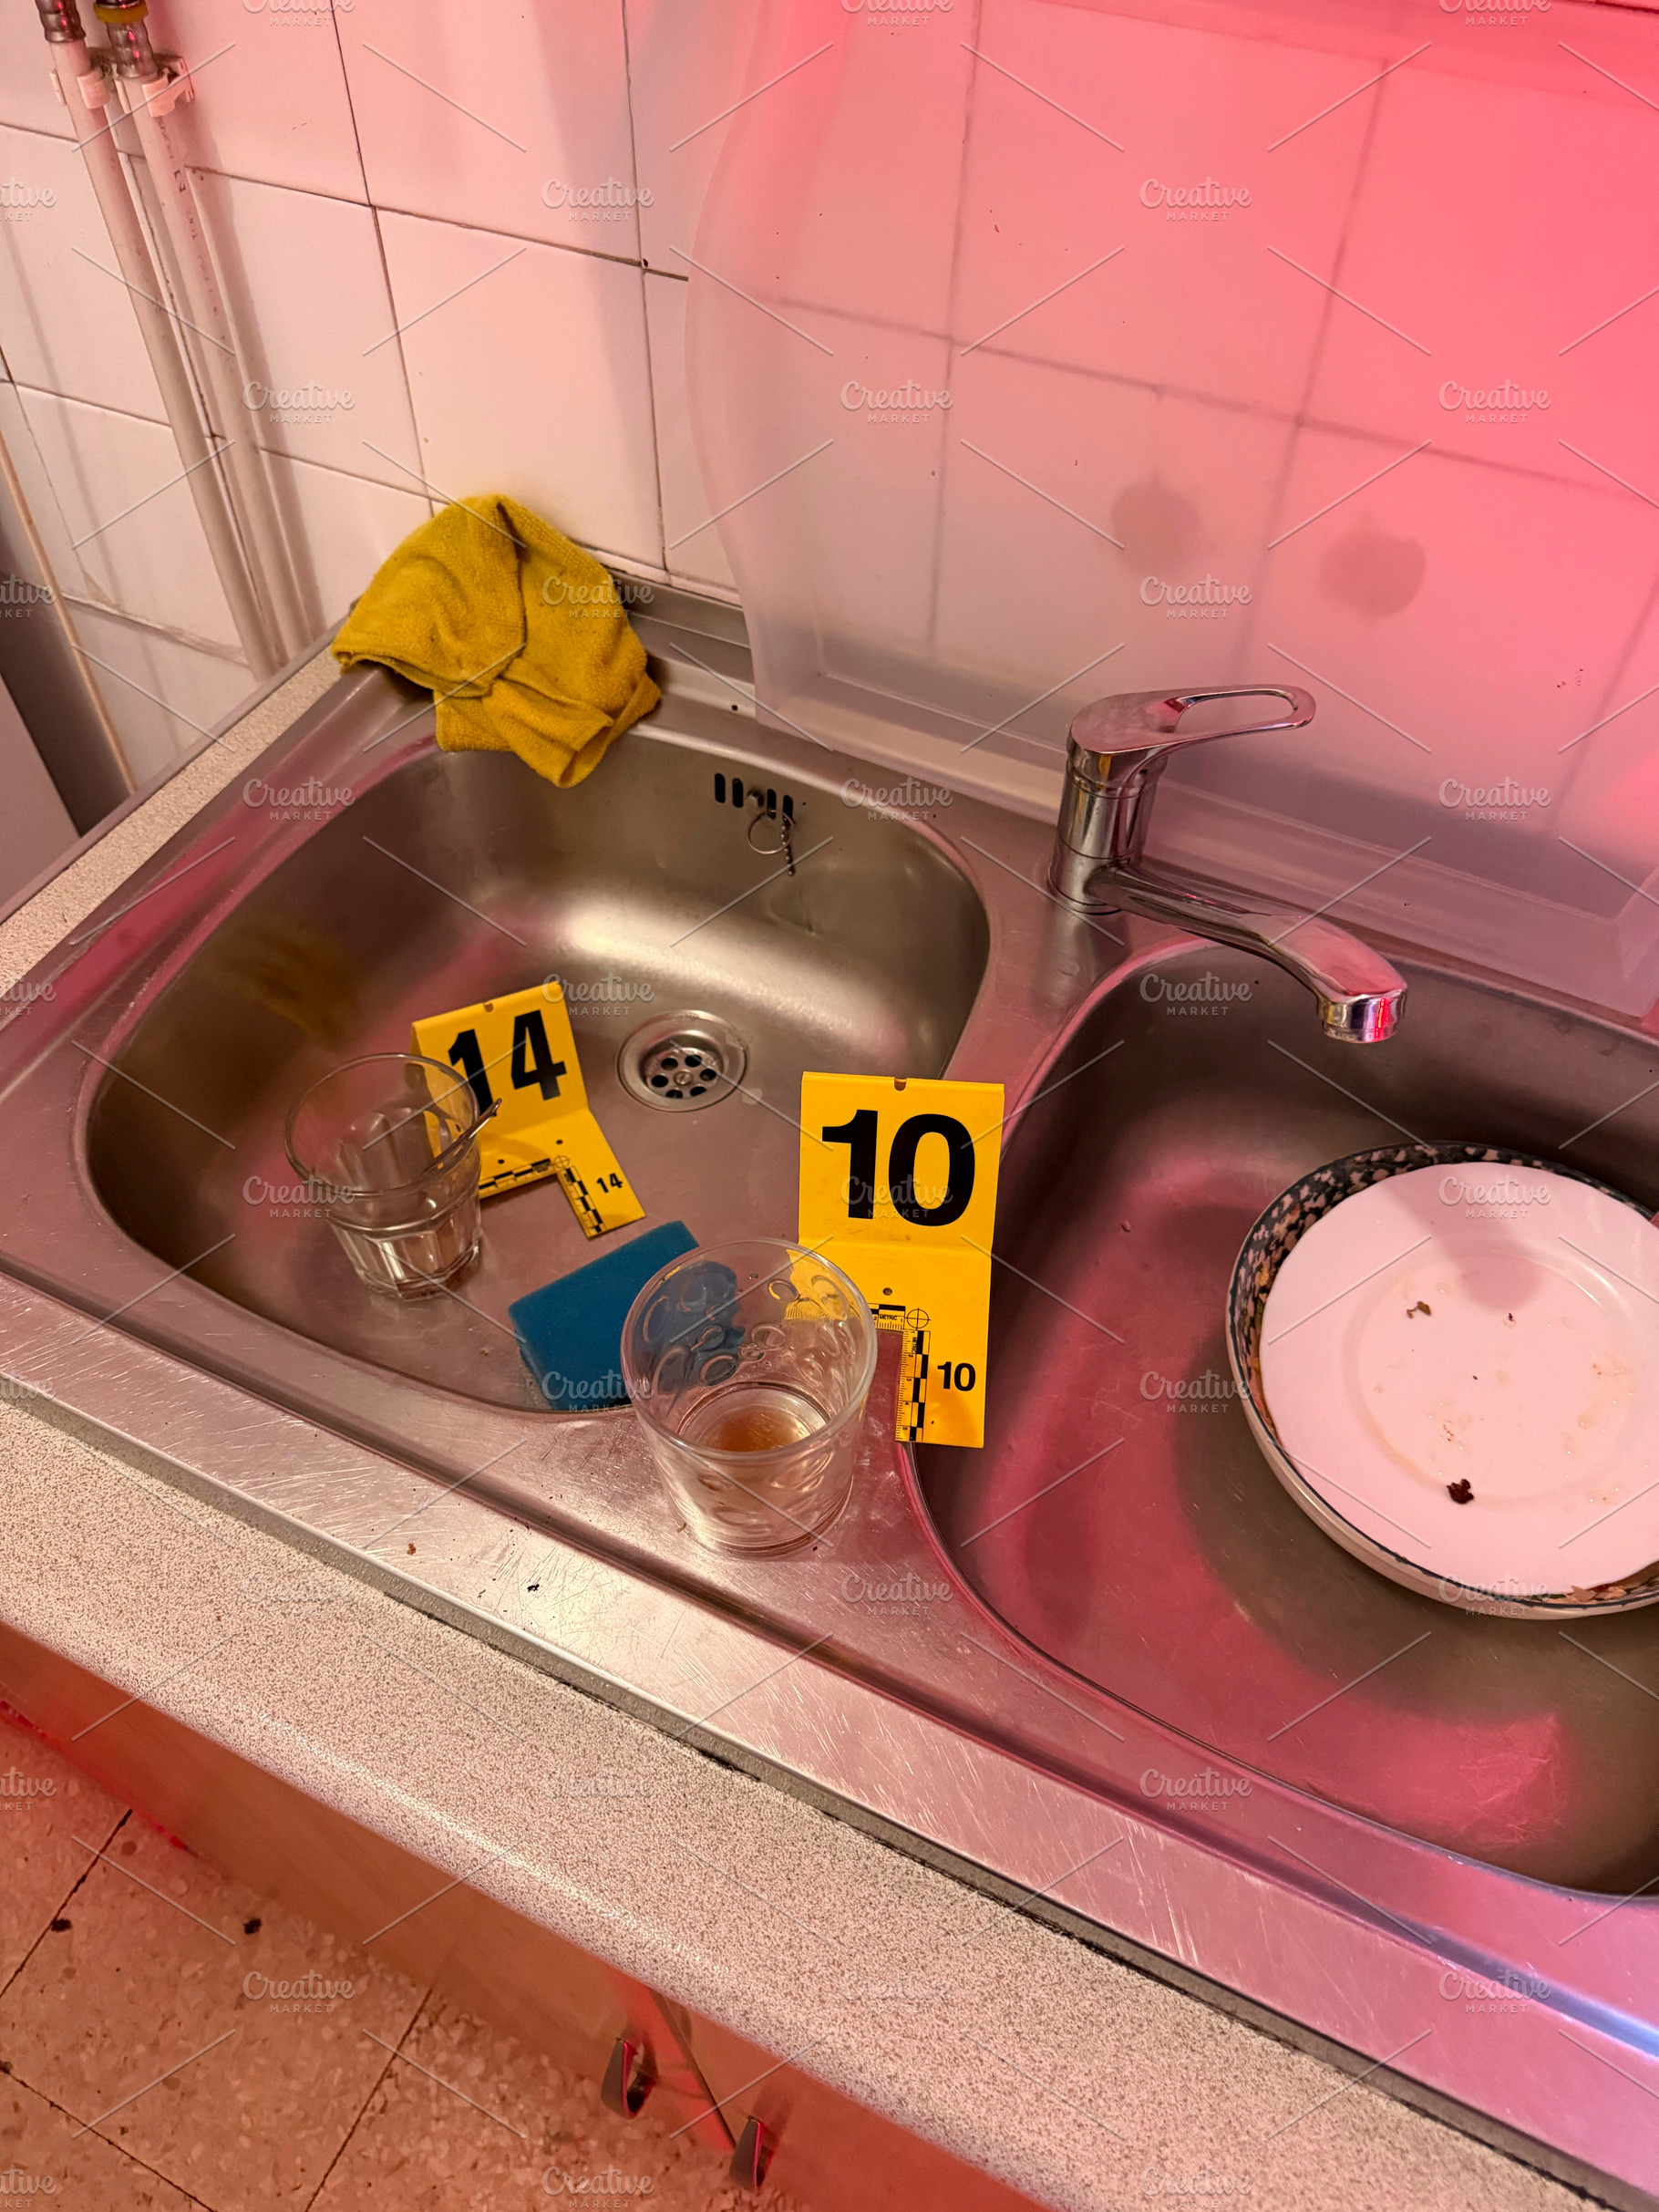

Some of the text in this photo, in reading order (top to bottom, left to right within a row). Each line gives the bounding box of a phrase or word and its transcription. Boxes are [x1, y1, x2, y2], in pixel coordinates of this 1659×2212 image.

[448, 1009, 567, 1117] 14
[596, 1173, 623, 1194] 14
[822, 1109, 975, 1227] 10
[937, 1361, 976, 1391] 10
